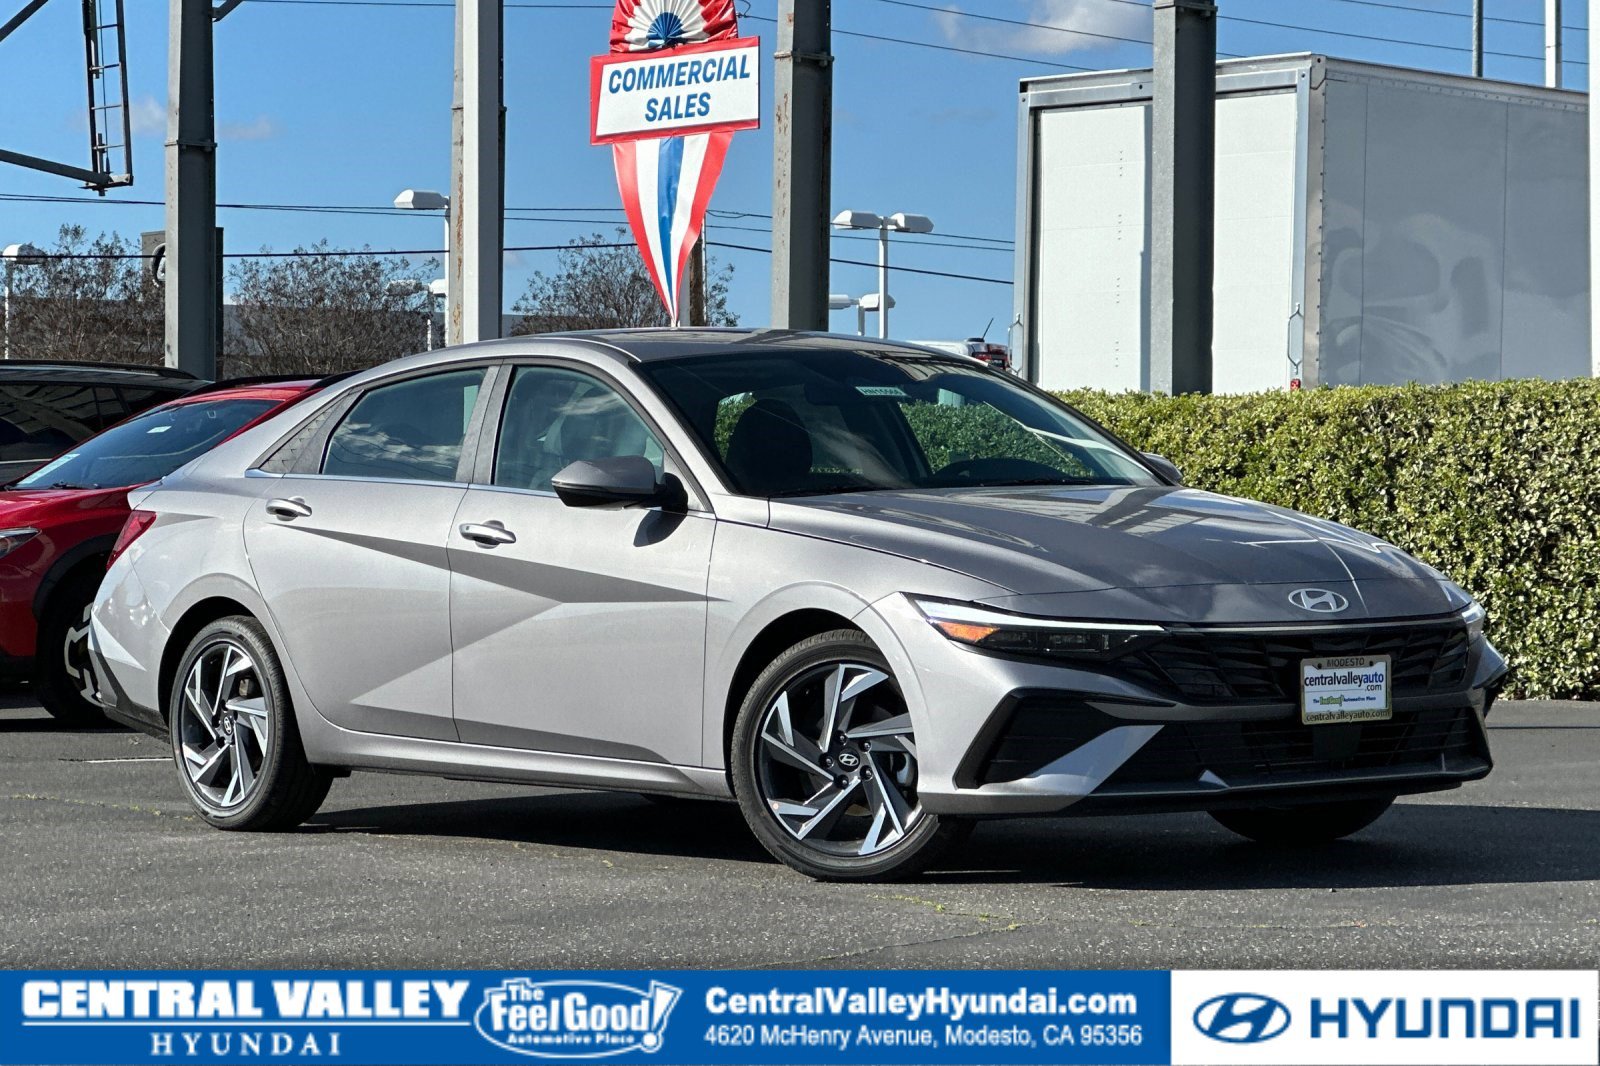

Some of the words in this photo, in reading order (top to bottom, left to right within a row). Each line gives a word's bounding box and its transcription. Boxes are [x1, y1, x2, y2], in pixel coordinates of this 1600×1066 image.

[608, 54, 751, 95] COMMERCIAL
[644, 91, 712, 122] SALES
[1327, 657, 1365, 667] MODESTO
[1304, 671, 1384, 687] centralvalleyauto
[1306, 709, 1390, 721] centralvalleyauto.com
